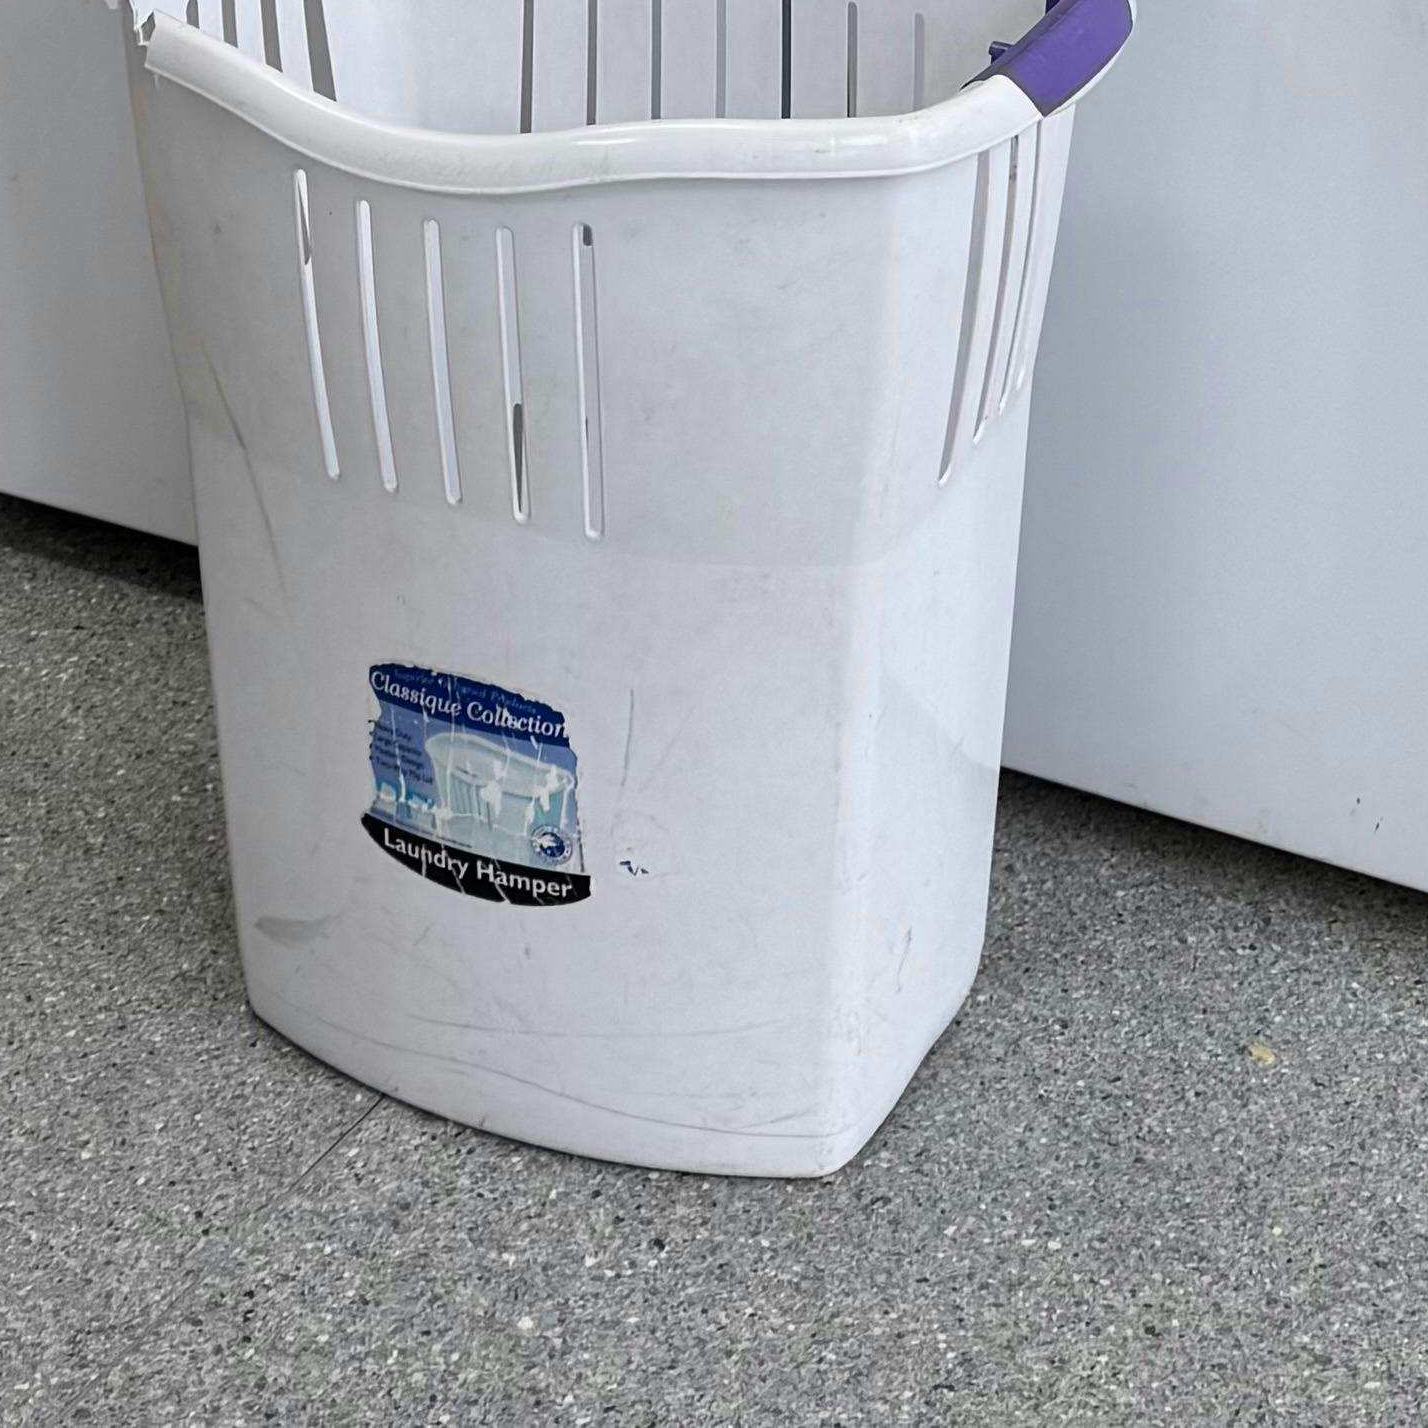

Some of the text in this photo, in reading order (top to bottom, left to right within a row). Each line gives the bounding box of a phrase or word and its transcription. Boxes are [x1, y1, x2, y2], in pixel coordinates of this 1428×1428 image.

[370, 670, 462, 717] Classique
[466, 700, 568, 739] Collection
[383, 827, 469, 880] Laundry
[476, 859, 573, 898] Hamper
